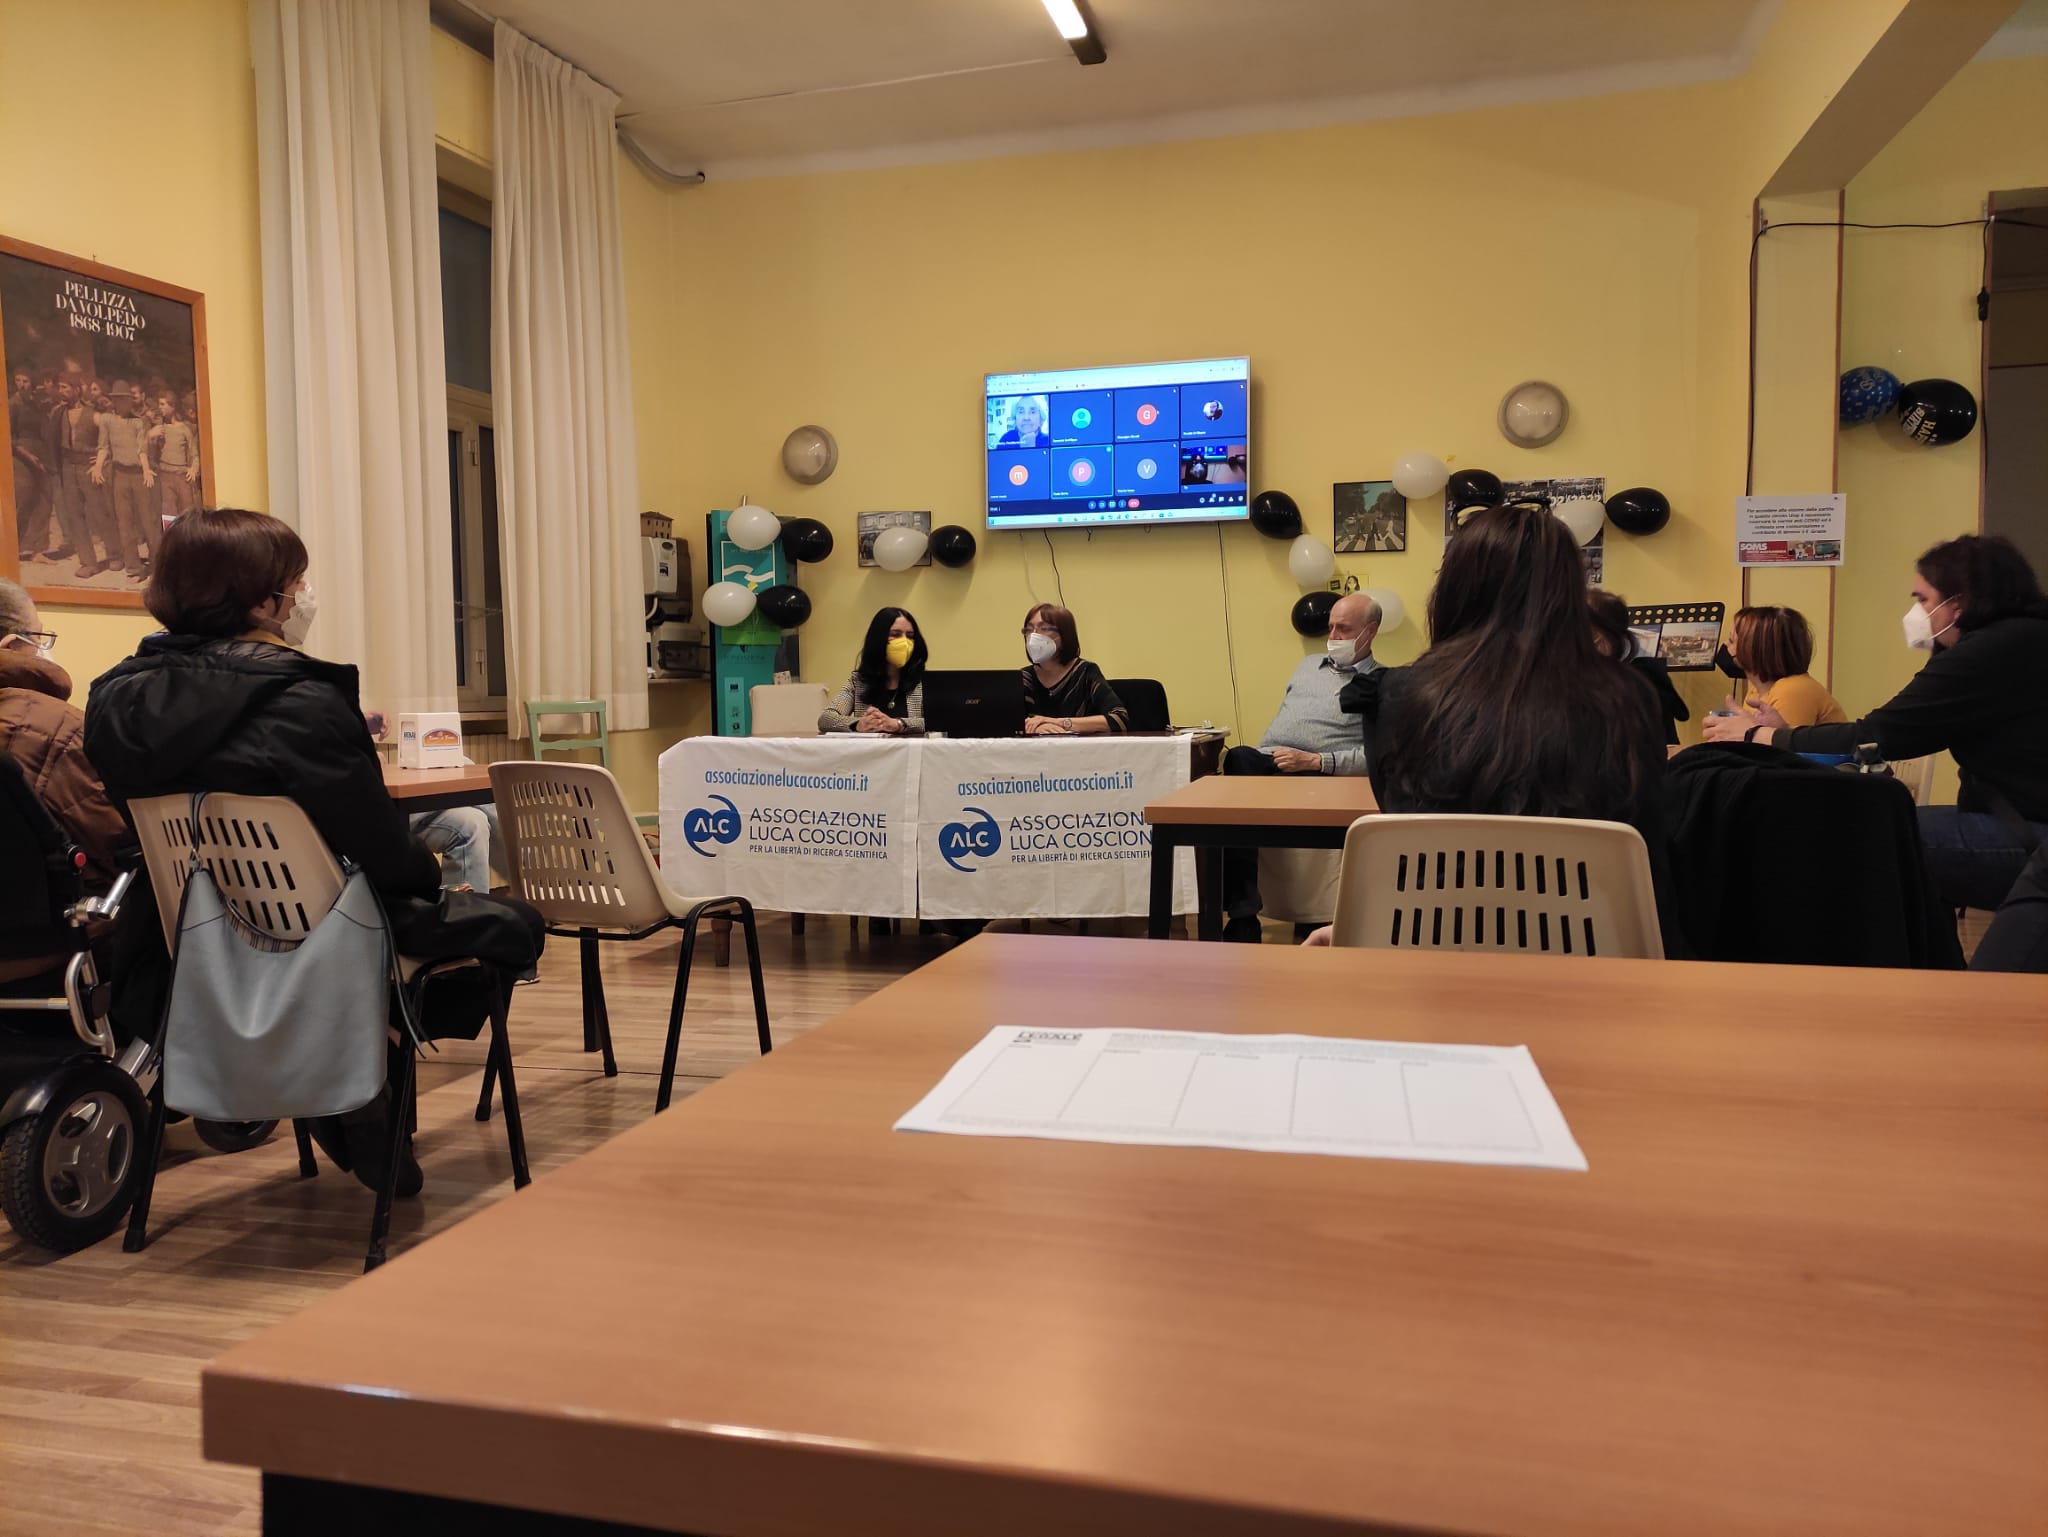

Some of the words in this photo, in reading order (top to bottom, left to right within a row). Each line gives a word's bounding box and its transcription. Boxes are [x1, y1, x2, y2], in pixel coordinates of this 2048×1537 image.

[65, 280, 136, 312] PELLIZZA
[56, 293, 77, 313] DA
[79, 299, 146, 329] VOLPEDO
[1078, 467, 1085, 476] P
[1143, 464, 1151, 474] V
[1740, 543, 1768, 551] SOMS
[705, 768, 869, 792] associazionelucacoscioni.it
[958, 771, 1133, 796] associazionelucacoscioni.it
[694, 817, 730, 834] ALC
[750, 808, 887, 828] ASSOCIAZIONE
[1009, 811, 1147, 832] ASSOCIAZION
[749, 825, 795, 842] LUCA
[799, 828, 887, 847] COSCIONI
[950, 830, 989, 848] ALC
[1010, 834, 1059, 850] LUCA
[1063, 830, 1153, 849] COSCION
[749, 845, 763, 853] PER
[764, 845, 773, 854] LA
[774, 845, 802, 855] LIBERTÀ
[803, 847, 811, 855] DI
[813, 847, 843, 857] RICERCA
[844, 849, 888, 860] SCIENTIFICA
[1011, 855, 1026, 863] PER
[1028, 854, 1037, 863] LA
[1038, 852, 1068, 862] LIBERTÀ
[1069, 853, 1078, 861] DI
[1080, 851, 1112, 861] RICERCA
[1114, 850, 1152, 860] SCIENTIFI
